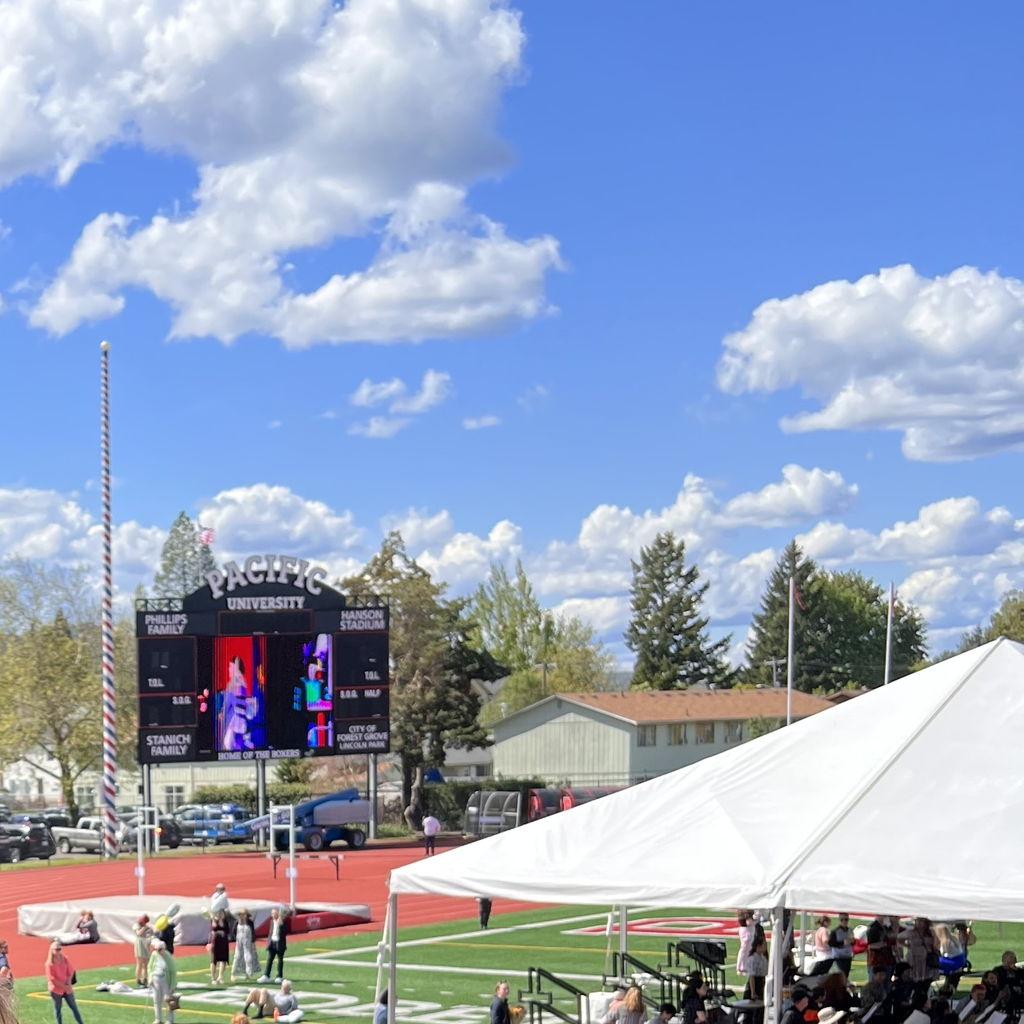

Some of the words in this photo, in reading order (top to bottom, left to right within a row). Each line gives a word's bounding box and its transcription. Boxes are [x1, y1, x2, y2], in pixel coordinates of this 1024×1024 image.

[205, 554, 327, 599] PACIFIC
[227, 596, 305, 610] UNIVERSITY
[145, 614, 187, 625] PHILLIPS
[341, 610, 383, 621] HANSON
[147, 624, 185, 635] FAMILY
[340, 620, 385, 630] STADIUM
[349, 725, 367, 733] CITY
[368, 724, 377, 732] OF
[146, 734, 191, 746] STANICH
[337, 733, 363, 741] FOREST
[364, 732, 388, 740] GROVE
[151, 744, 188, 755] FAMILY
[340, 741, 365, 750] LINCOLN
[366, 740, 385, 748] PARK
[218, 752, 241, 760] HOME
[243, 751, 254, 760] OF
[255, 750, 270, 759] THE
[271, 749, 300, 759] BOXERS
